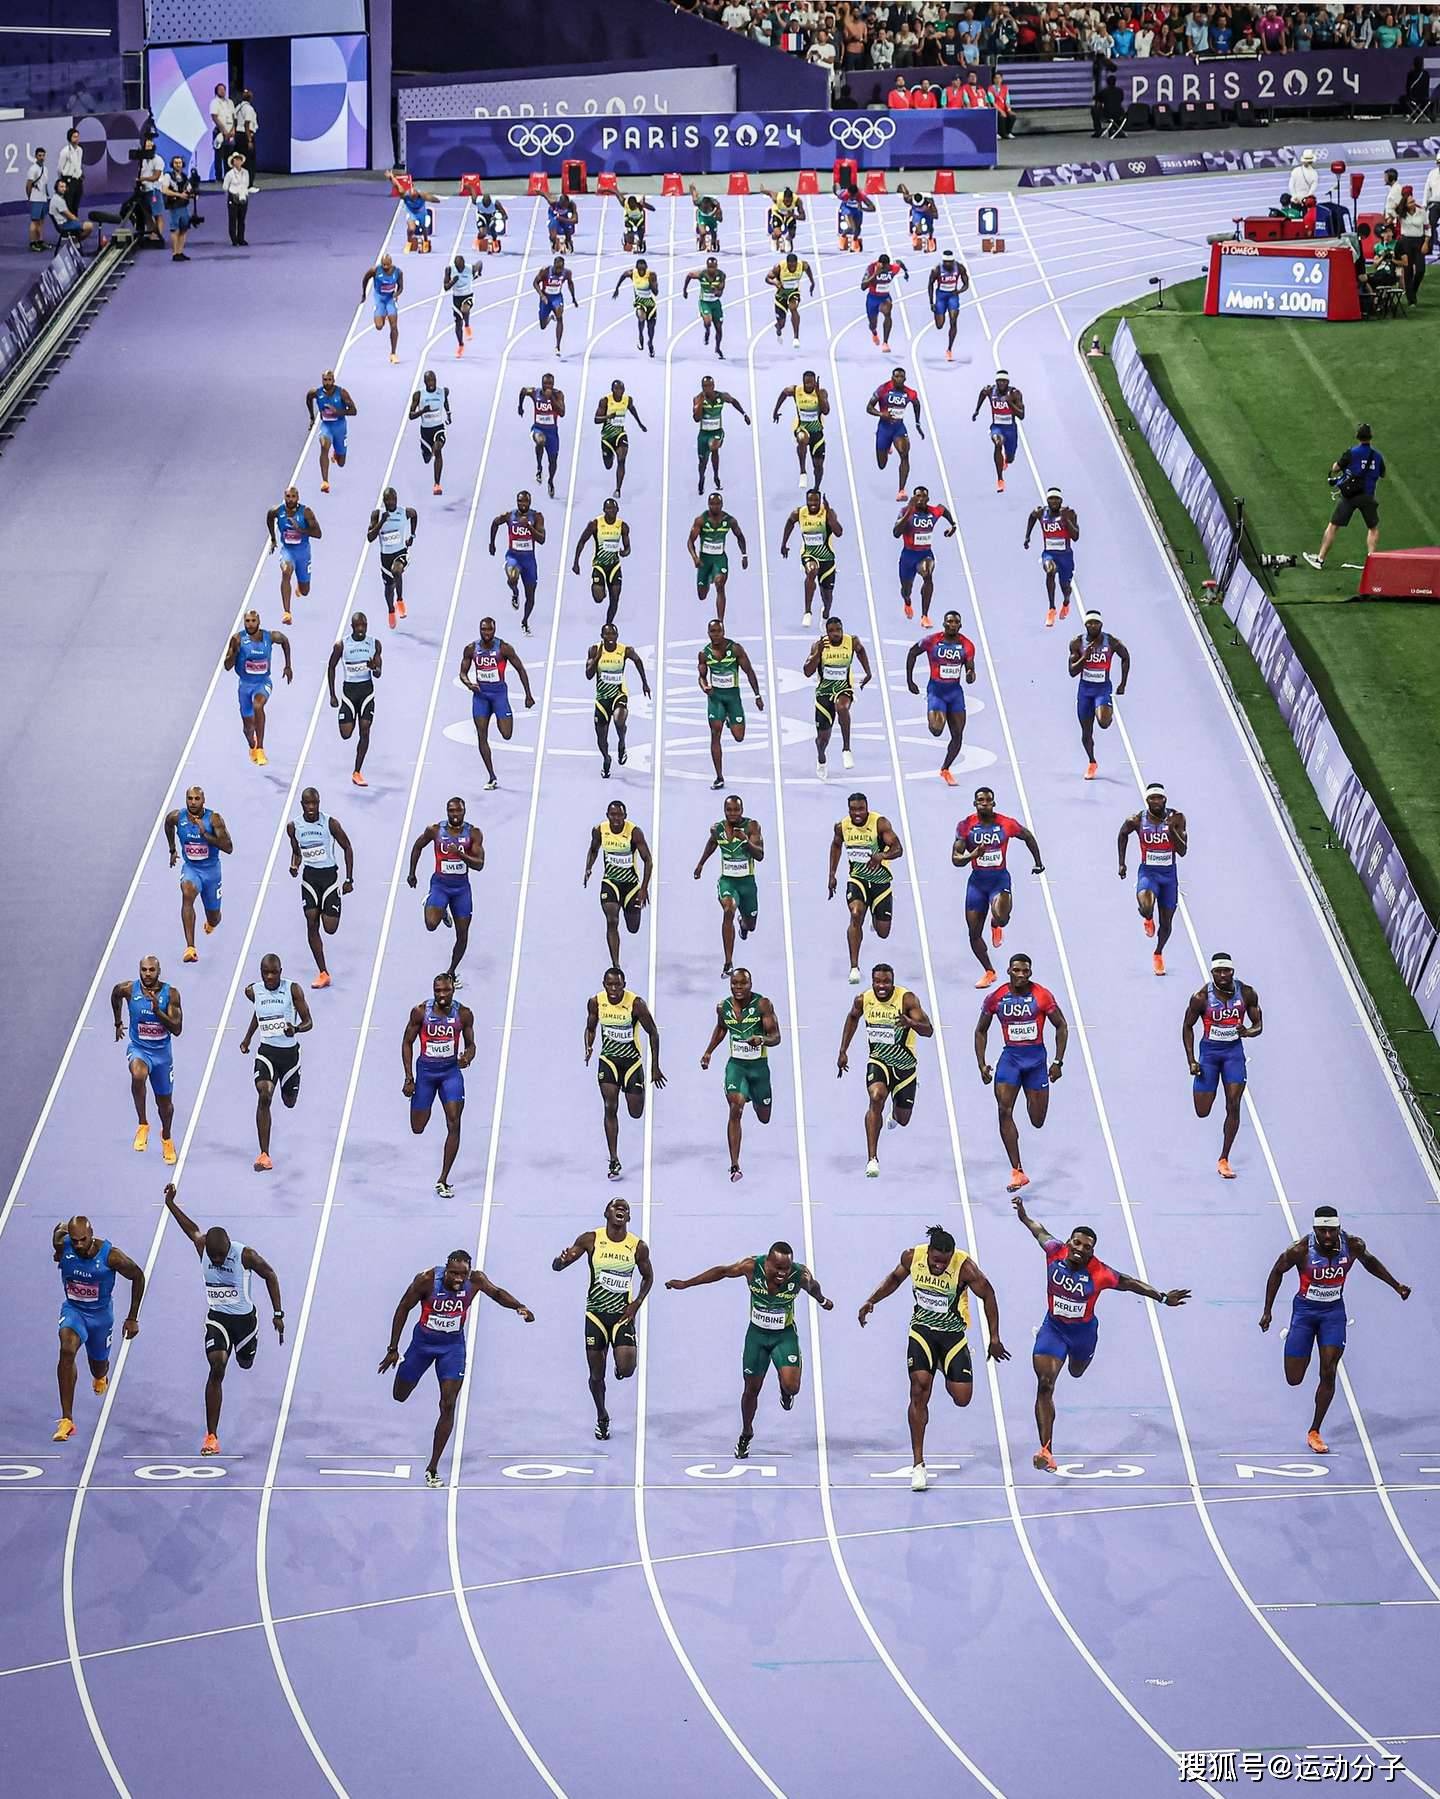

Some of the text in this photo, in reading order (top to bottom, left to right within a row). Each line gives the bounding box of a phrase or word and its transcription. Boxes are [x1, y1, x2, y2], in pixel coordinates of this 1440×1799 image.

[1258, 67, 1360, 98] 2024
[714, 123, 801, 148] 2024
[982, 212, 993, 231] 1
[1231, 247, 1259, 256] OMEGA
[1292, 262, 1323, 284] 9.6
[1226, 290, 1326, 312] Men's 100m
[888, 395, 905, 405] USA
[992, 401, 1009, 409] USA
[536, 402, 552, 411] USA
[913, 518, 933, 528] USA
[1043, 522, 1061, 532] USA
[512, 525, 531, 535] USA
[938, 649, 961, 660] USA
[476, 656, 498, 667] USA
[847, 834, 873, 842] JAMAICA
[973, 832, 1001, 845] USA
[1143, 832, 1170, 844] USA
[441, 843, 465, 854] UA
[602, 1012, 626, 1020] JAMAICA
[868, 1010, 898, 1021] JAMAICA
[1003, 1004, 1033, 1017] USA
[1212, 1008, 1240, 1021] USA
[427, 1025, 454, 1037] USA
[607, 1030, 631, 1039] SEVILLE
[1010, 1025, 1035, 1035] KERLEY
[600, 1252, 630, 1262] JAMAICA
[73, 1270, 92, 1278] ITALIA
[1313, 1266, 1344, 1280] USA
[602, 1275, 629, 1289] SEVILLE
[914, 1273, 950, 1290] JAMAICA
[1052, 1269, 1085, 1297] USA
[207, 1289, 239, 1299] TEBOGO
[433, 1300, 464, 1312] USA
[1054, 1300, 1084, 1314] KERLEY
[753, 1311, 784, 1324] SIMBINE
[134, 1464, 227, 1481] 8
[319, 1464, 411, 1479] 7
[684, 1463, 777, 1479] 5
[1055, 1463, 1146, 1478] 3
[1235, 1463, 1330, 1479] 2
